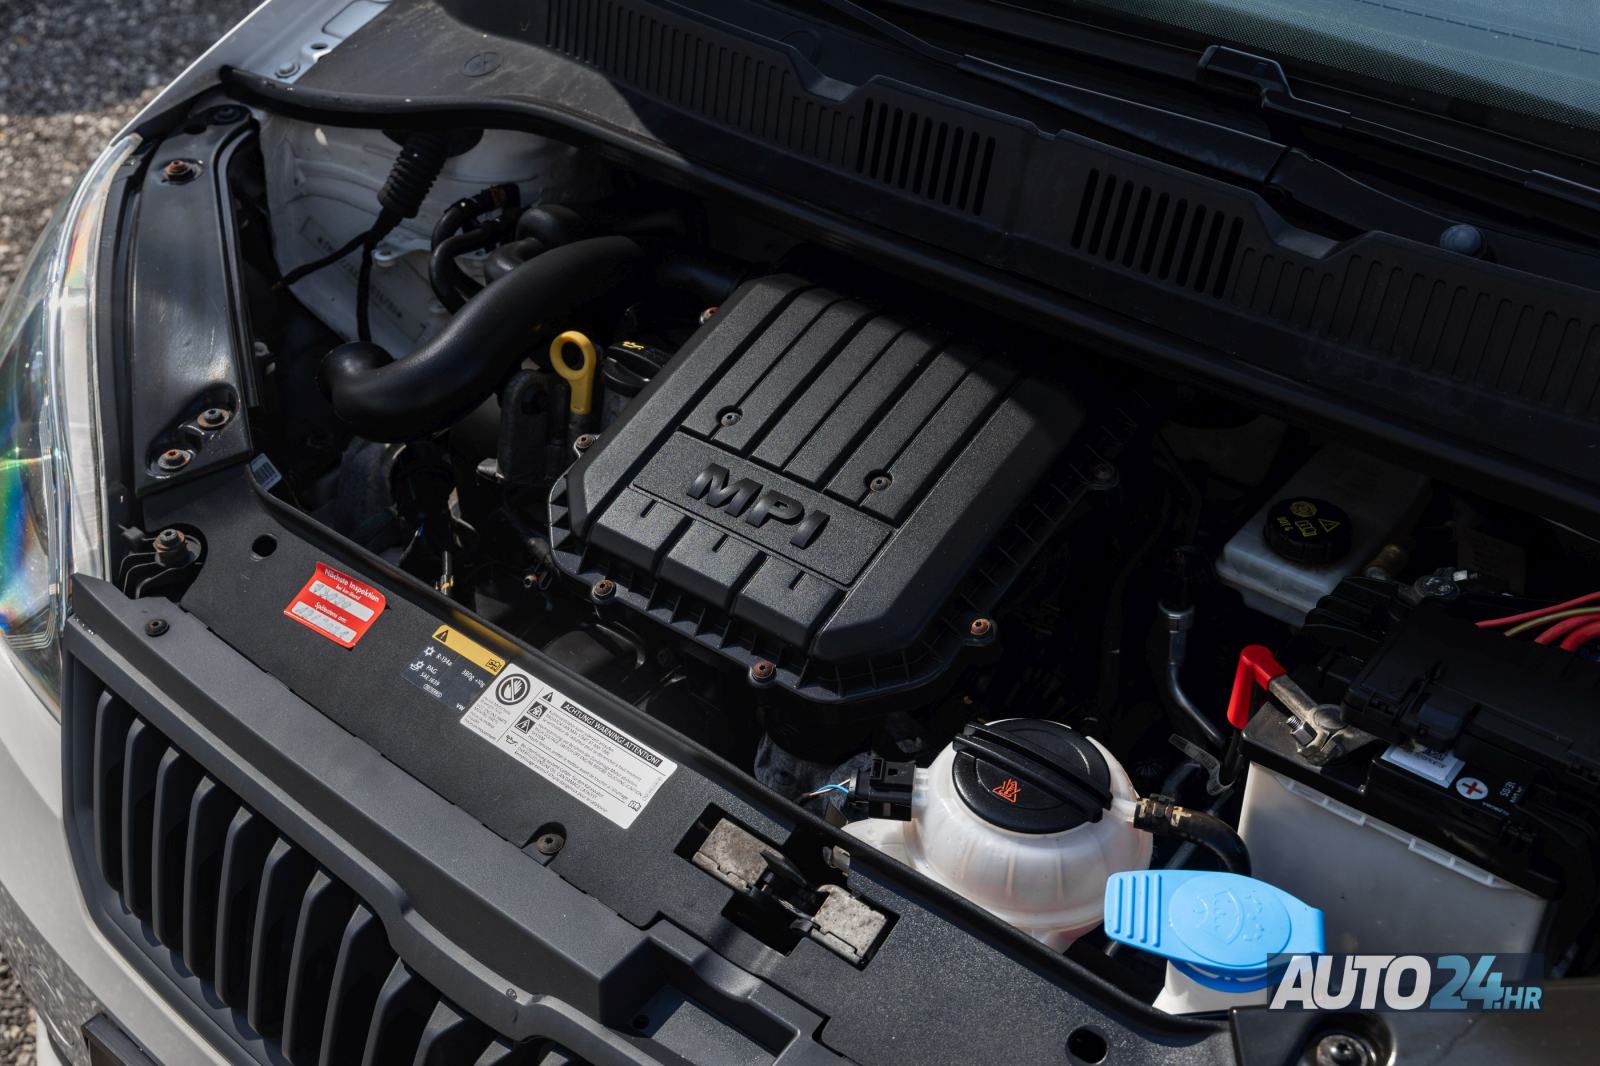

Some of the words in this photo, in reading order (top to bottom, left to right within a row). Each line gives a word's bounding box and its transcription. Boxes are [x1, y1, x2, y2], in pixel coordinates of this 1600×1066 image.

[686, 462, 831, 550] MPI
[324, 568, 349, 586] Nächste
[349, 581, 380, 602] Inspektion
[425, 664, 438, 675] PAG
[435, 653, 453, 667] R-134a
[461, 669, 475, 681] 380g
[562, 703, 595, 725] ACHTUNG!
[593, 721, 625, 744] WARNING!
[623, 740, 660, 765] ATTENTION!
